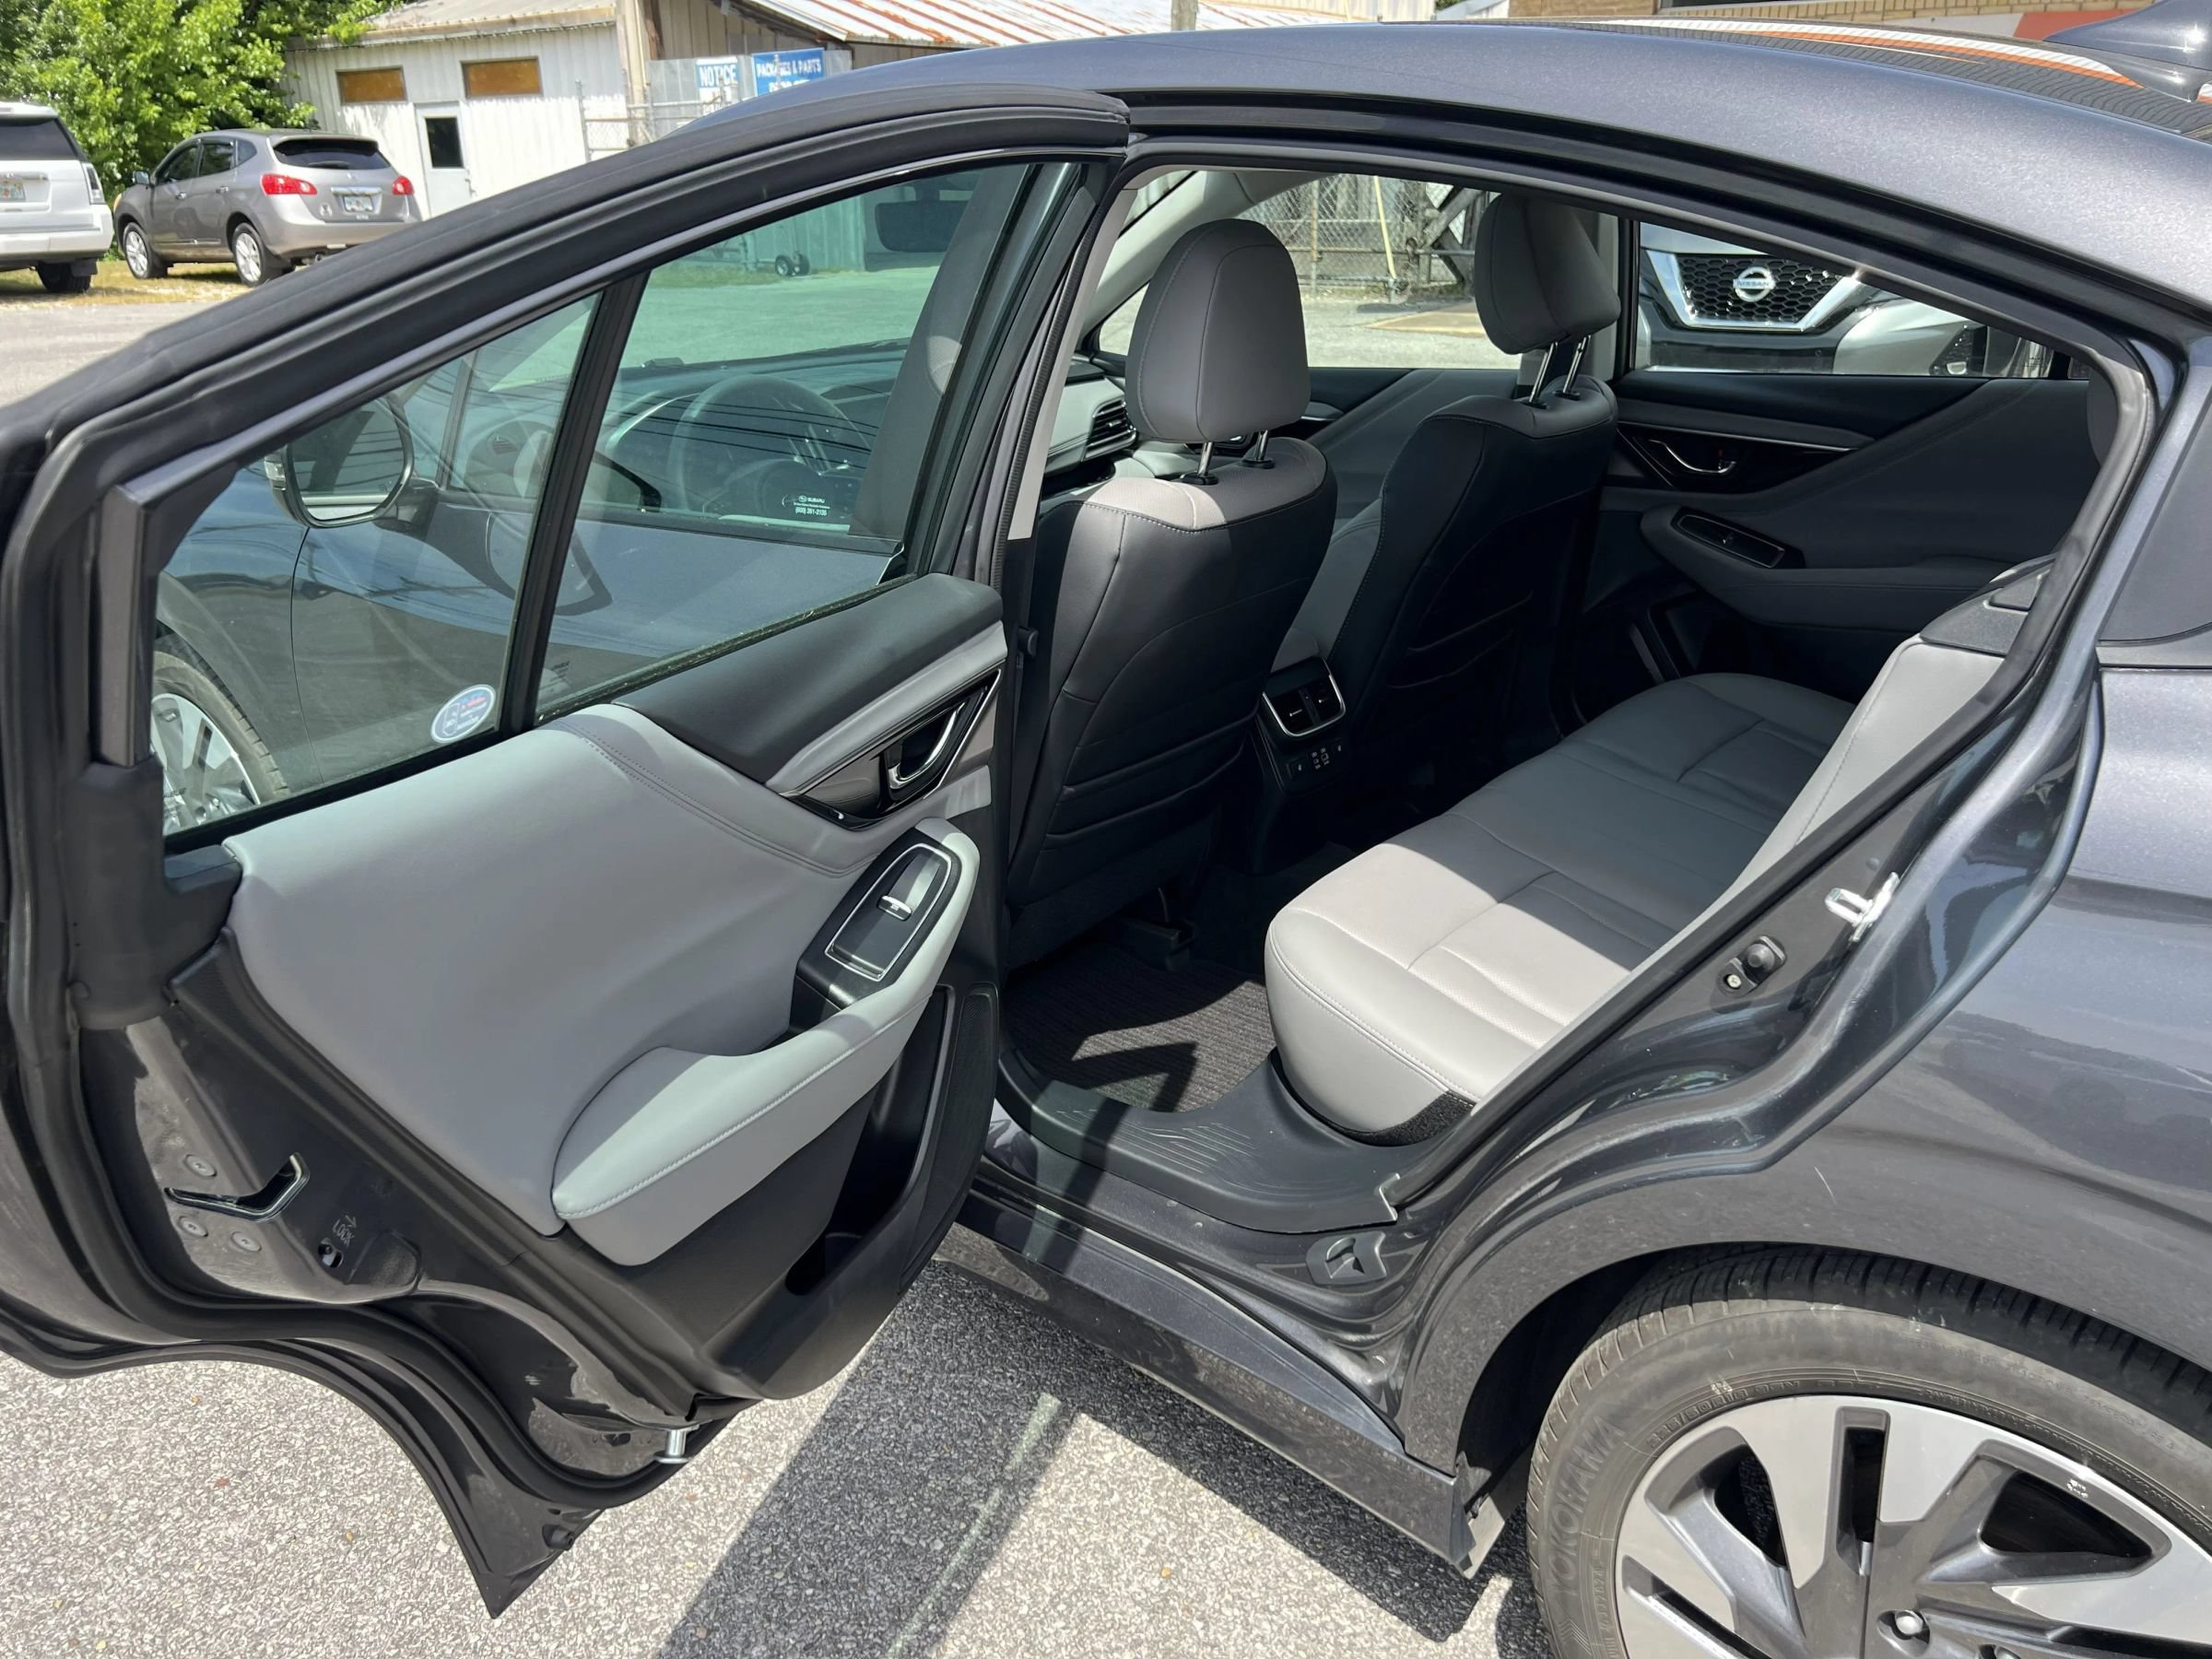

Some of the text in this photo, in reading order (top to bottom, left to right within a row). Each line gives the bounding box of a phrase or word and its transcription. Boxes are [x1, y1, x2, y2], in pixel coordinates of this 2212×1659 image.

[699, 64, 737, 87] NOTICE
[798, 58, 822, 74] PARTS
[332, 1218, 355, 1248] LOCK
[1548, 1416, 1625, 1596] YOKOHAMA
